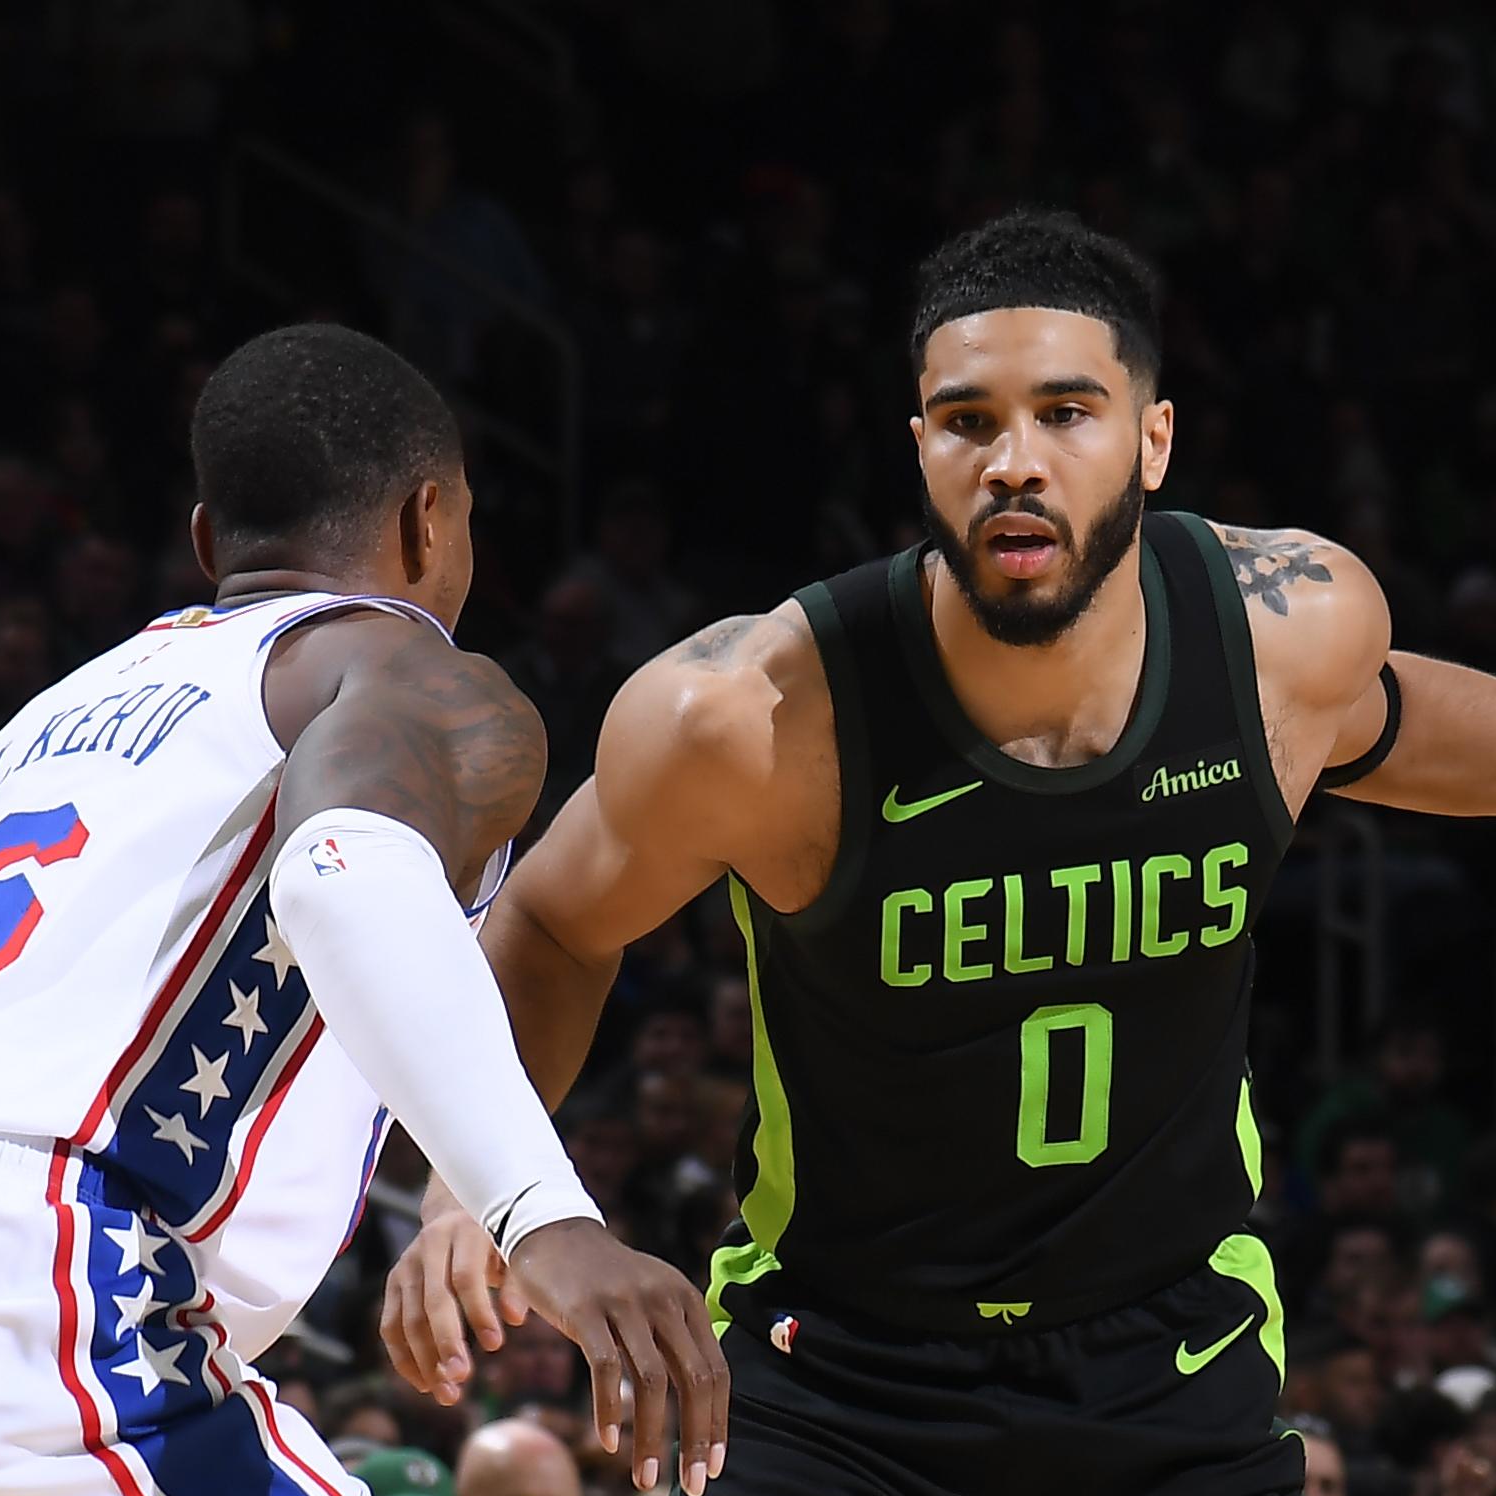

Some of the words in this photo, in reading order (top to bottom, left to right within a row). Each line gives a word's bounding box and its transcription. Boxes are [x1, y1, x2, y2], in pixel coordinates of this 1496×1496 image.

[1141, 758, 1242, 802] Amica
[880, 841, 1249, 988] CELTICS
[1015, 1002, 1114, 1169] 0
